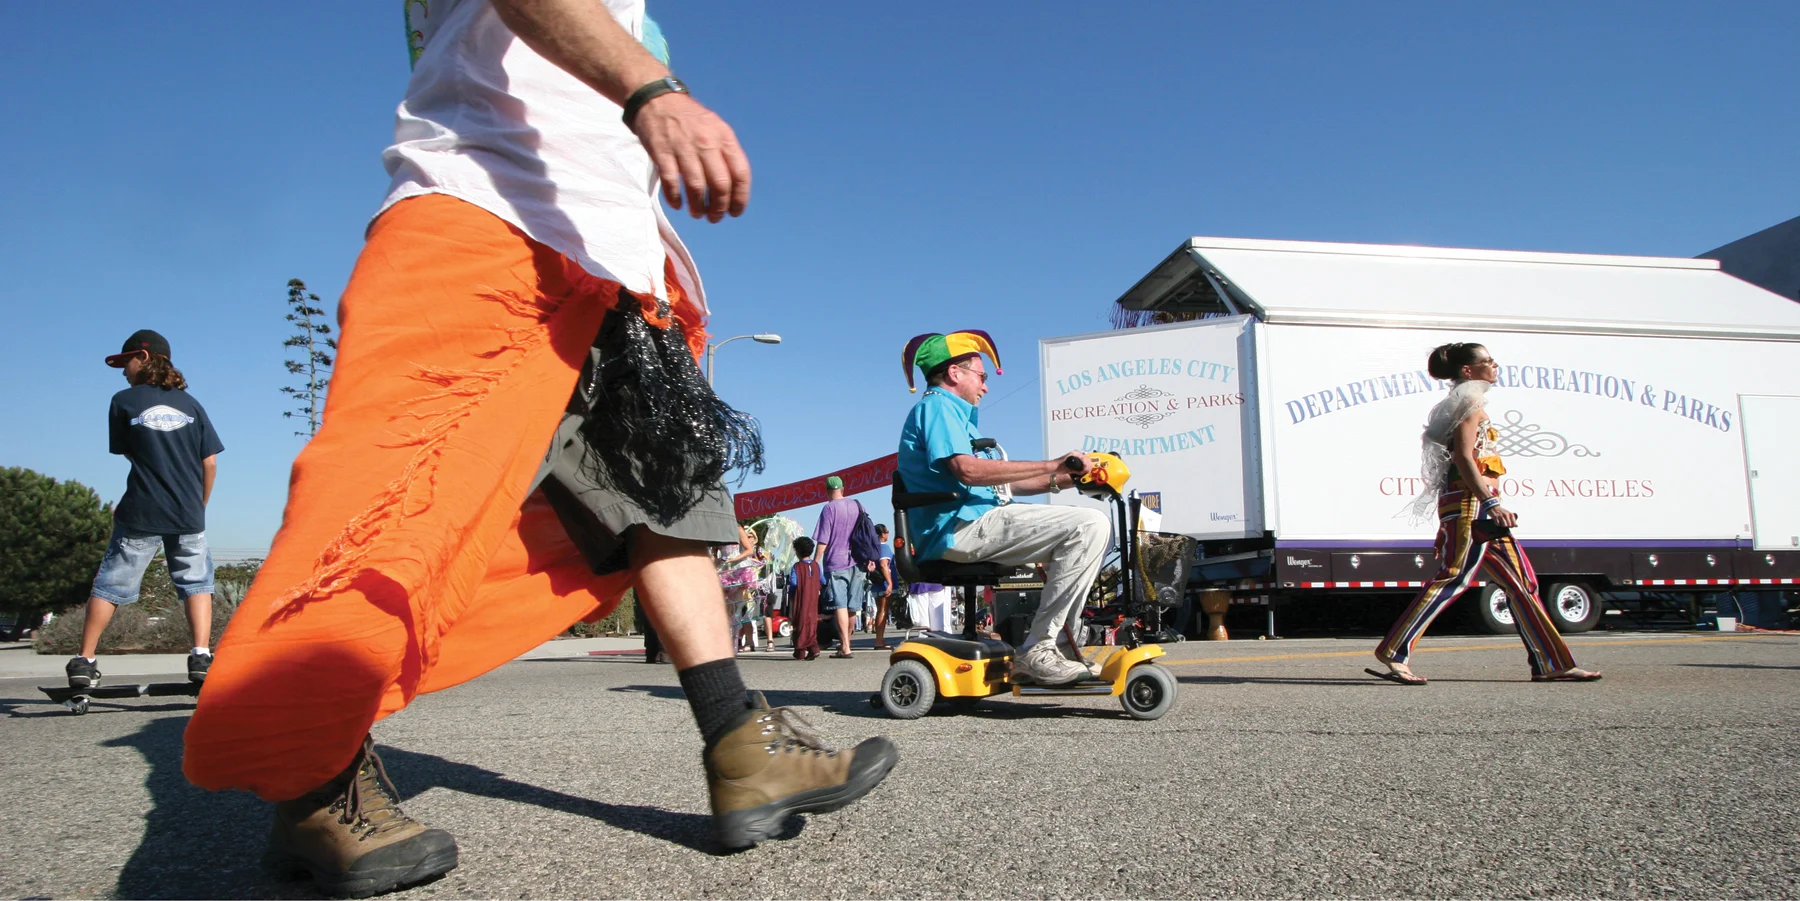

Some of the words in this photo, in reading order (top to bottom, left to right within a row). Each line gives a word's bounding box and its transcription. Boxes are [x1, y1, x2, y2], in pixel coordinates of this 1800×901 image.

[1056, 370, 1092, 396] LOS
[1097, 358, 1182, 383] ANGELES
[1187, 359, 1235, 384] CITY
[1051, 400, 1159, 421] RECREATION
[1166, 398, 1180, 411] &
[1187, 392, 1245, 409] PARKS
[1640, 384, 1657, 408] &
[1662, 389, 1732, 433] PARKS
[1081, 424, 1216, 456] DEPARTMENT
[1502, 478, 1535, 498] OS
[1544, 478, 1654, 498] ANGELES
[1210, 512, 1236, 523] Wenger
[1286, 556, 1311, 568] Wenger
